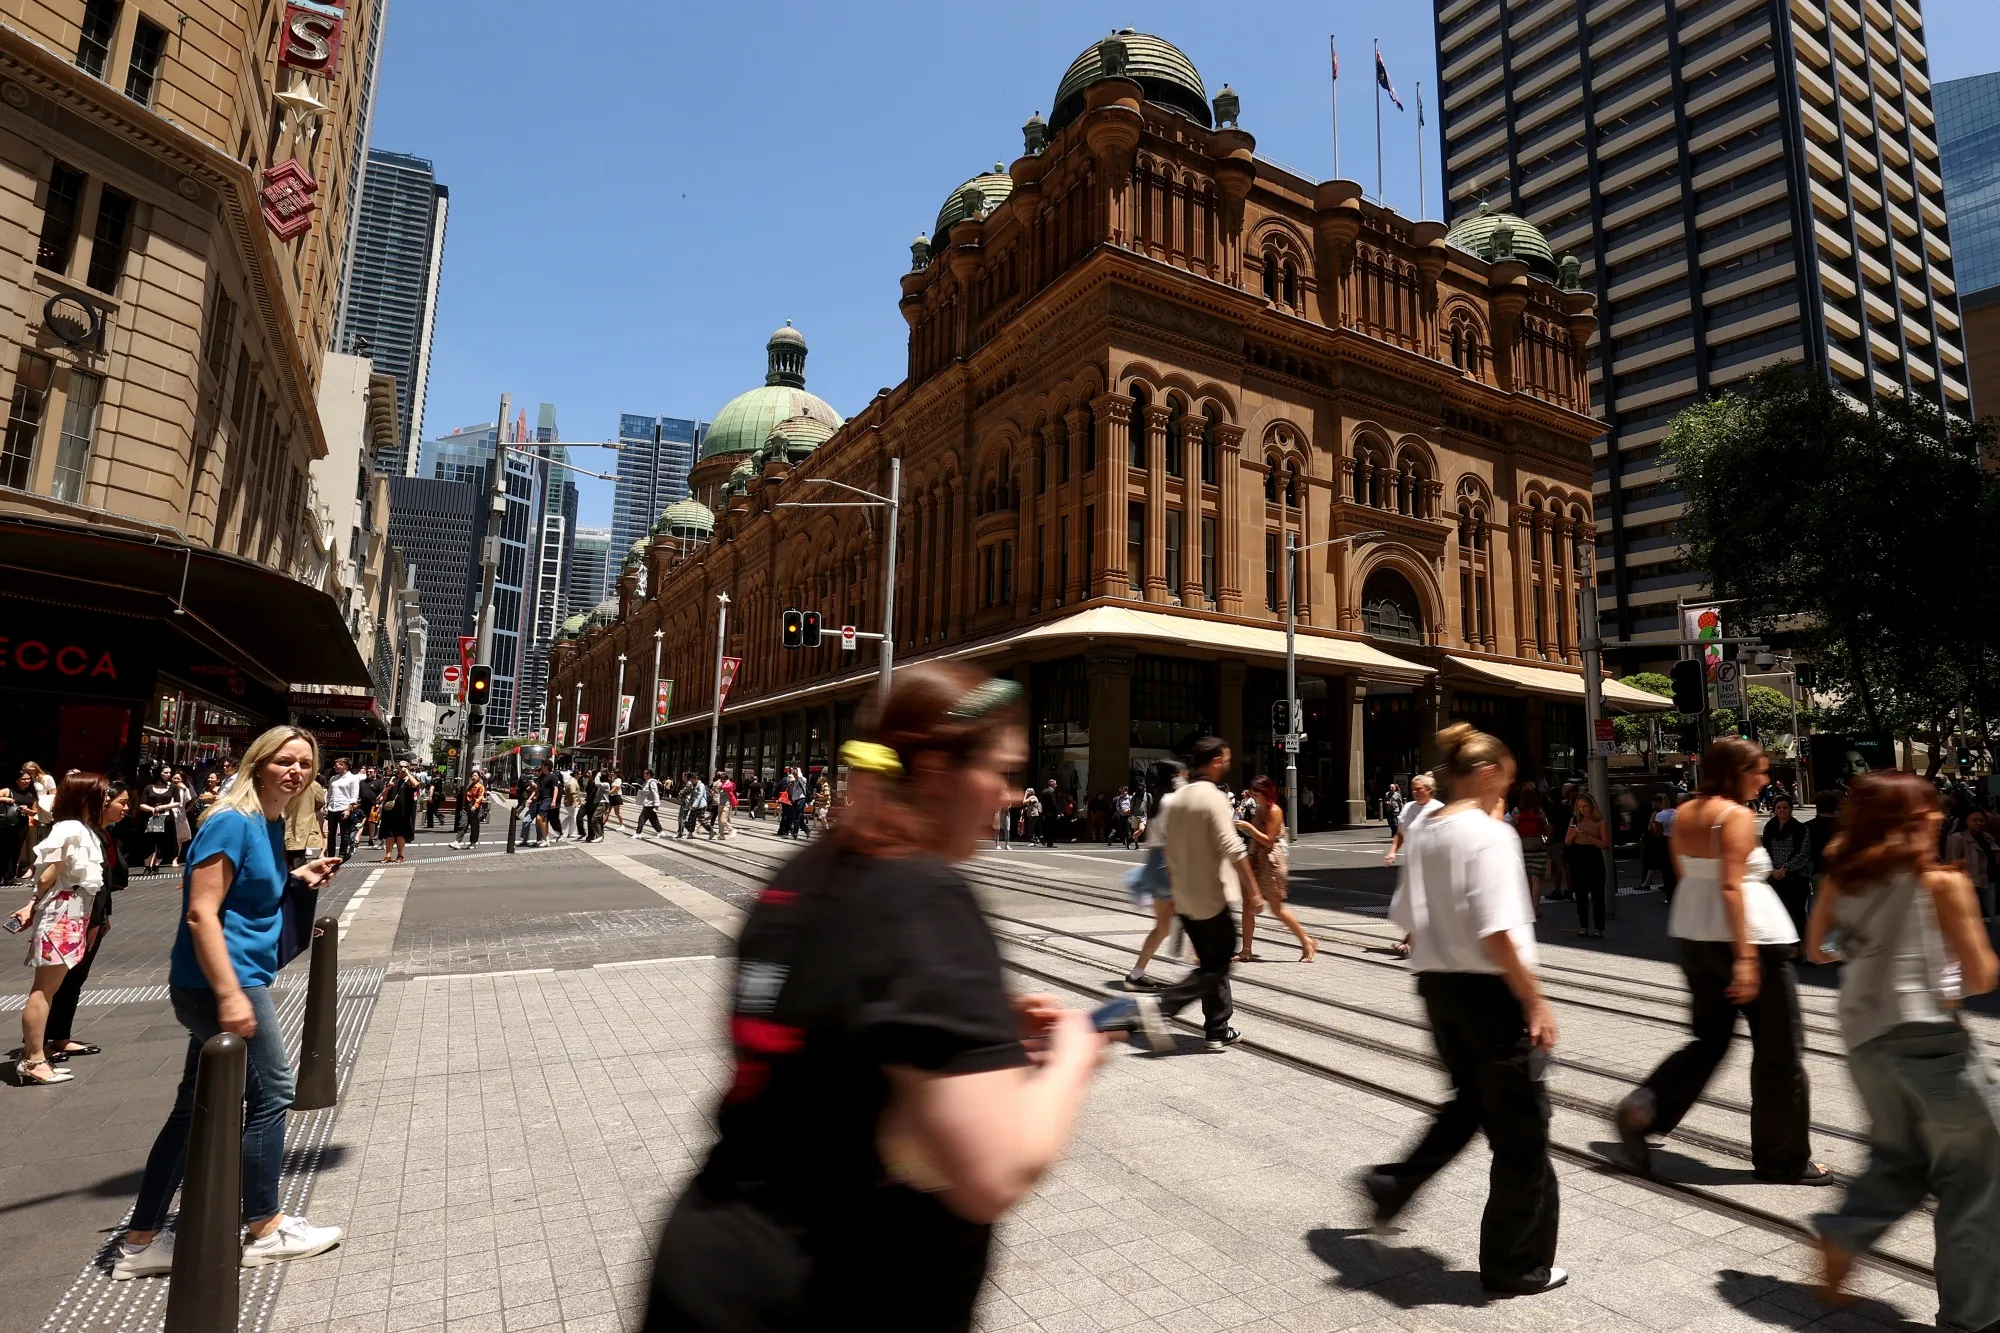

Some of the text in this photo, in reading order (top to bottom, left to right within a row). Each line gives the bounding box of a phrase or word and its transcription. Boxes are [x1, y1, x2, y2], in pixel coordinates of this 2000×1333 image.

[274, 190, 313, 217] GRILL
[1722, 684, 1734, 692] NO
[293, 695, 331, 705] Kidstuff
[311, 729, 343, 738] Kidstuff
